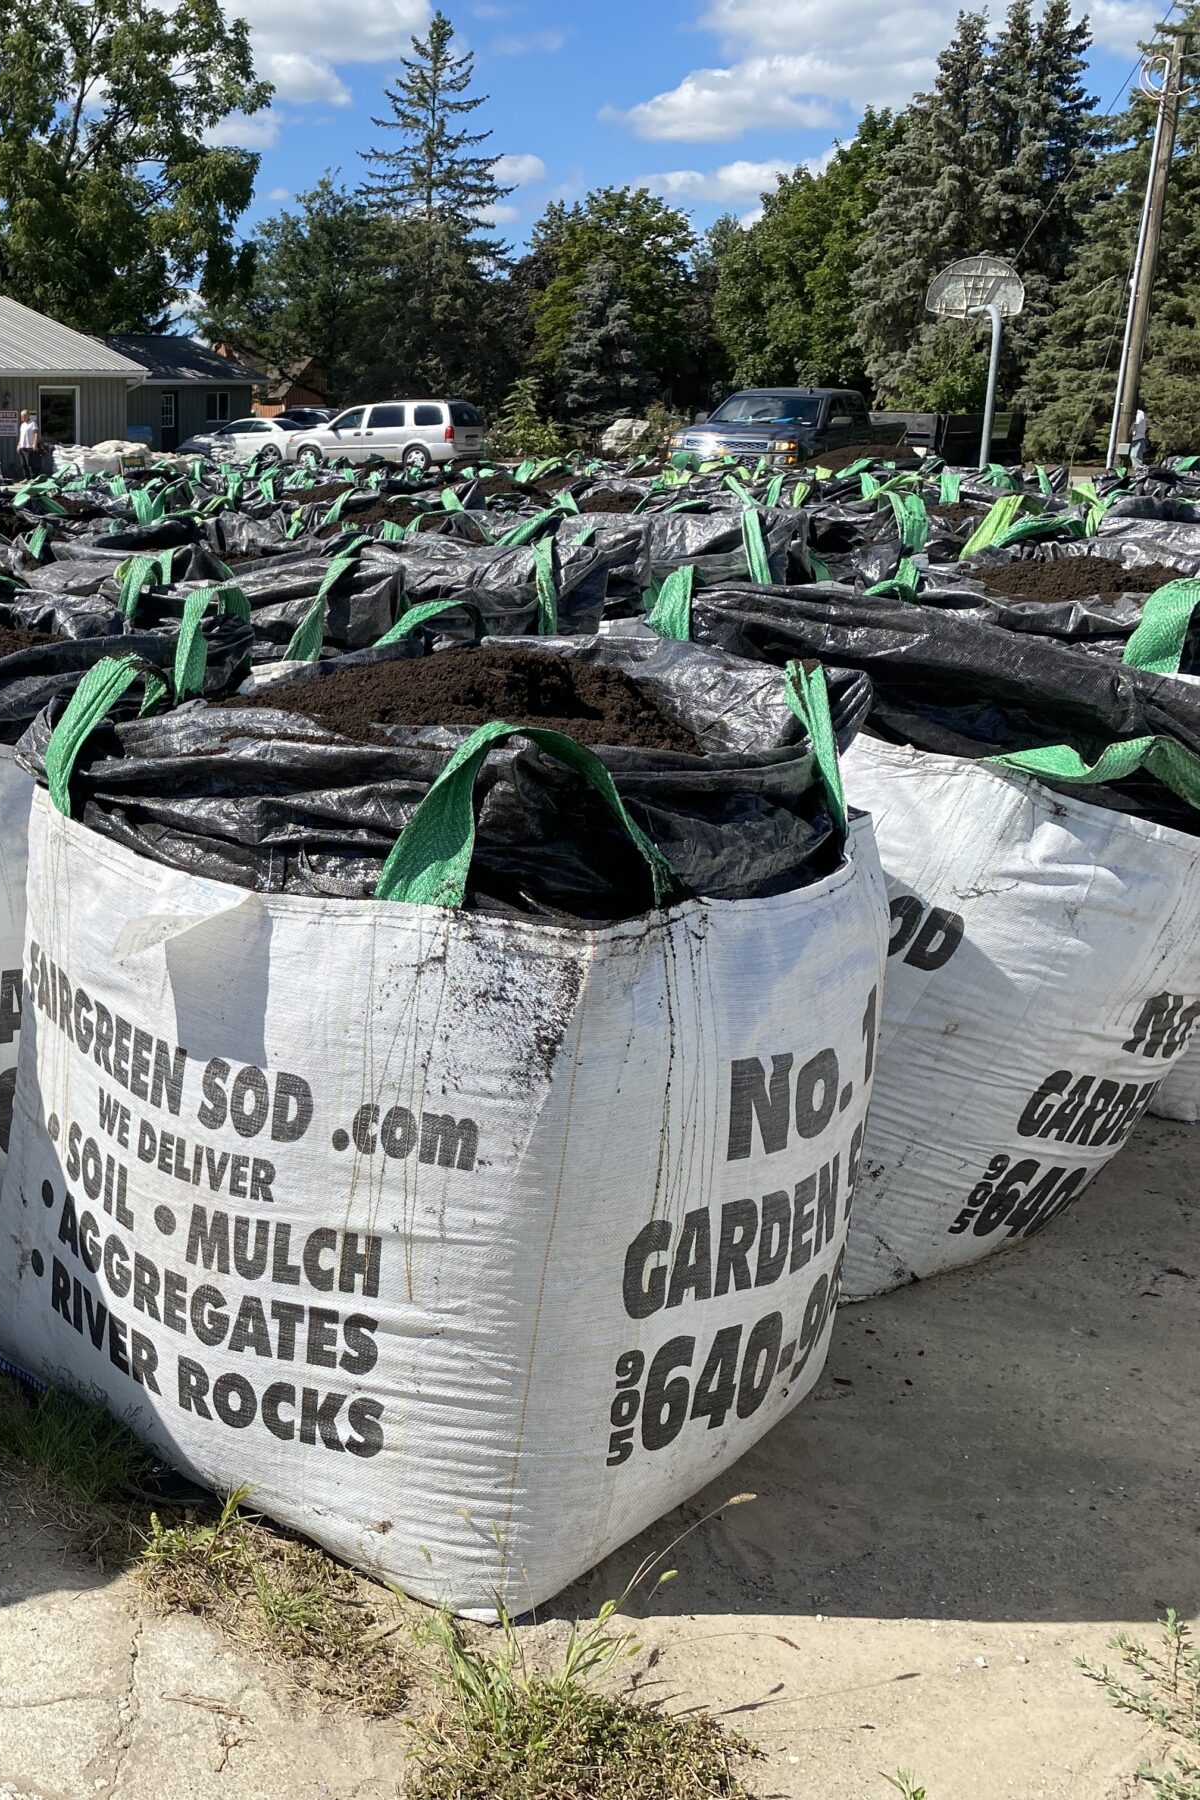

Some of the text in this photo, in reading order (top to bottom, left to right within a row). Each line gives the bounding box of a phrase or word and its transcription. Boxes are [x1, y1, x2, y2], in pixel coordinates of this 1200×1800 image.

[29, 940, 187, 1117] FAIRGREEN
[197, 1057, 314, 1143] SOD
[331, 1101, 481, 1172] .com
[98, 1086, 130, 1149] WE
[137, 1118, 276, 1203] DELIVER
[727, 983, 877, 1162] No. 1
[57, 1191, 380, 1376] AGGREGATES
[66, 1120, 382, 1299] SOIL MULCH
[622, 1151, 841, 1320] GARDEN
[947, 1153, 1088, 1238] 905 640
[51, 1254, 385, 1459] RIVER ROCKS
[606, 1240, 846, 1467] 905 640-9
